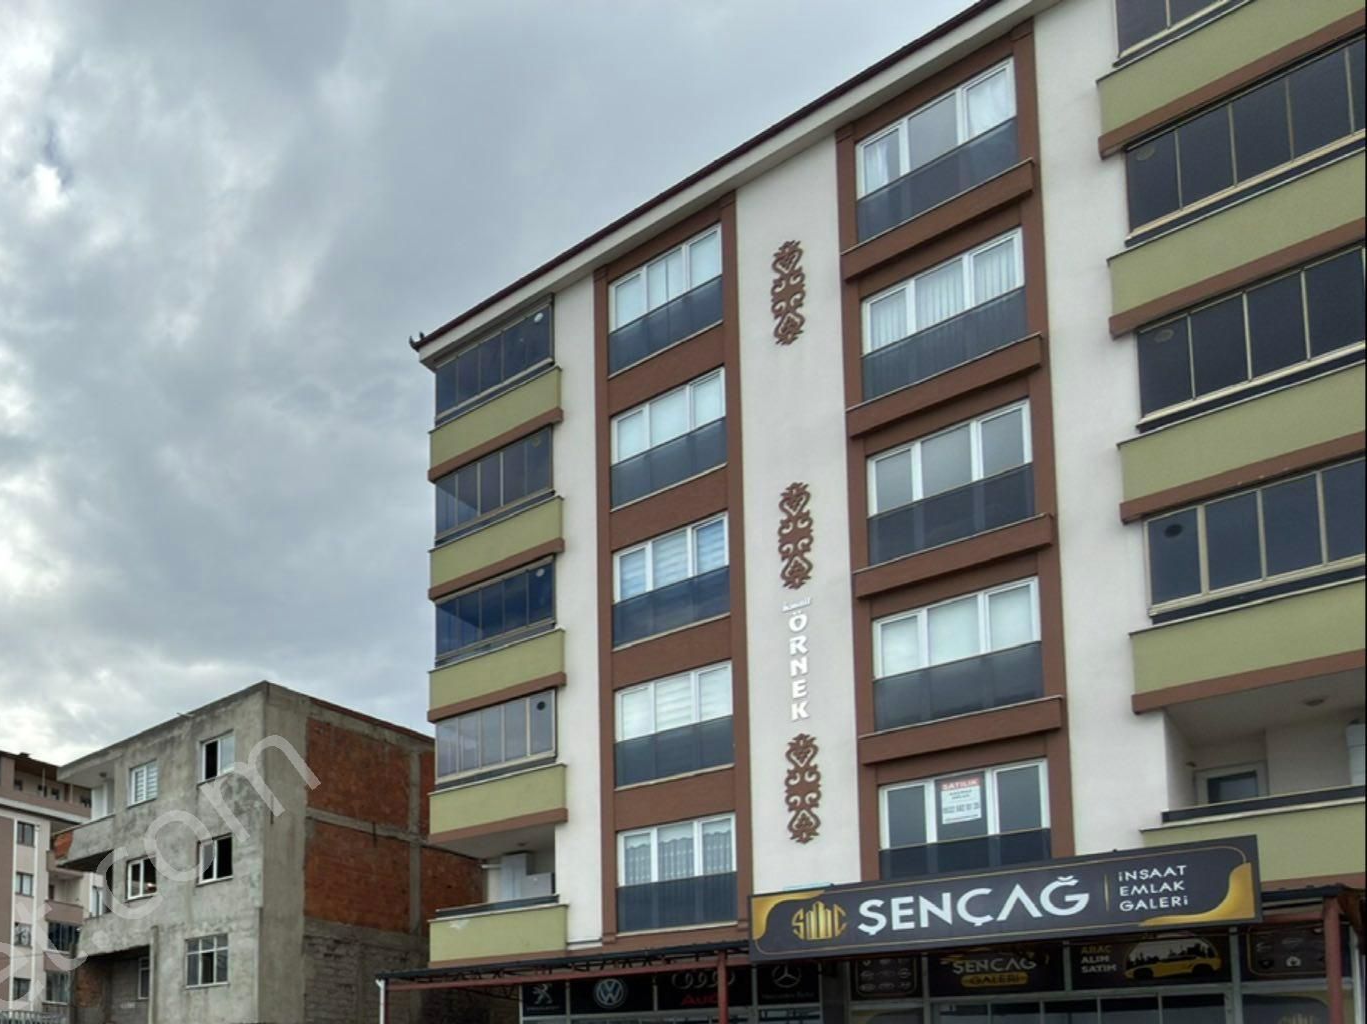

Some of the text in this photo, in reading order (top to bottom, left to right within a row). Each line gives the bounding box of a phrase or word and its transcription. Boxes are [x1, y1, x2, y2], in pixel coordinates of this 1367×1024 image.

[788, 610, 811, 722] ÖRNEK
[857, 875, 1090, 936] ŞENÇAĞ
[1119, 880, 1185, 897] EMLAK
[1119, 895, 1189, 912] GALERİ
